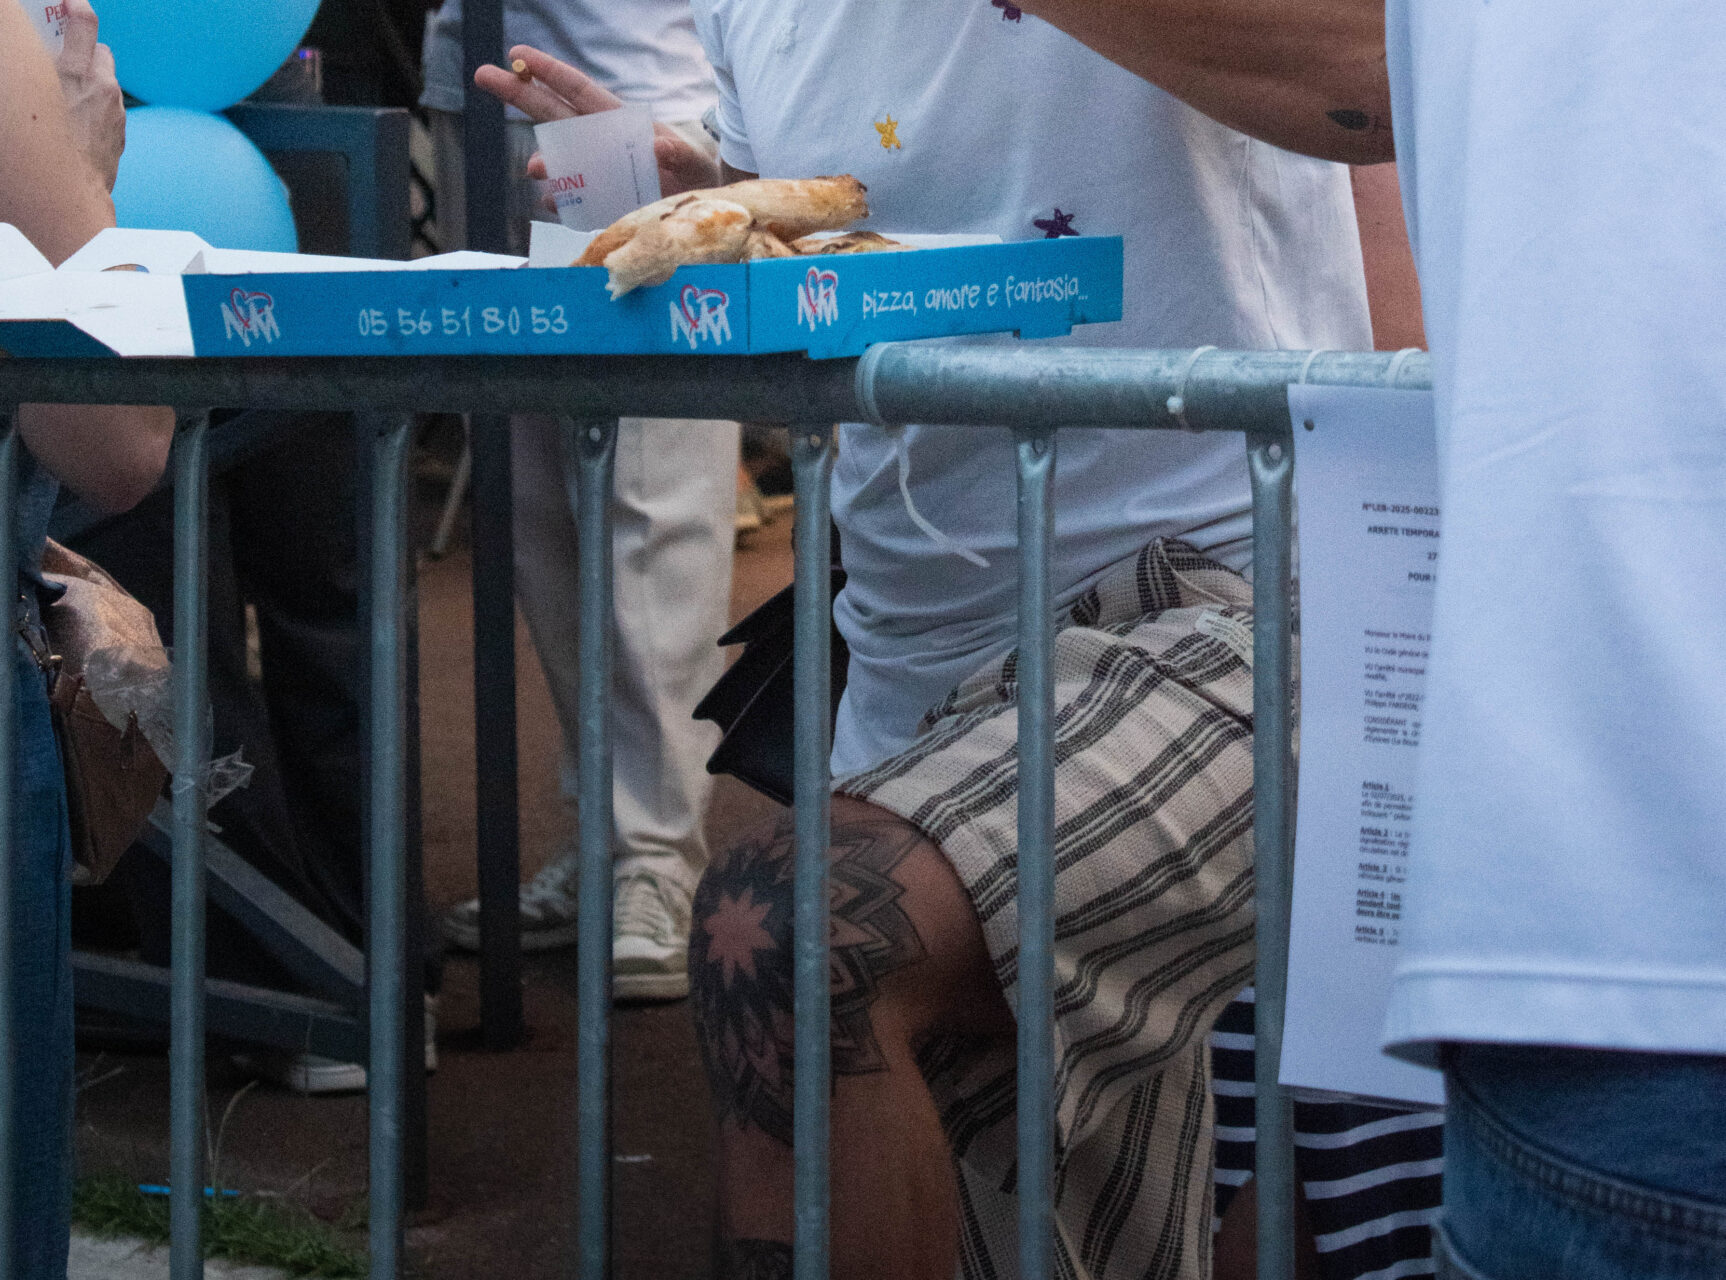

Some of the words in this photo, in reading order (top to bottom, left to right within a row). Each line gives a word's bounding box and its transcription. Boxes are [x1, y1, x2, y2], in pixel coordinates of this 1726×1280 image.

[862, 288, 918, 319] pizza,
[924, 284, 981, 312] amore
[986, 282, 998, 307] e
[1005, 274, 1089, 307] fantasia...
[358, 308, 388, 336] 05
[398, 308, 432, 336] 56
[441, 307, 472, 336] 51
[481, 306, 521, 336] 80
[530, 305, 569, 335] 53
[1408, 572, 1431, 582] POUR
